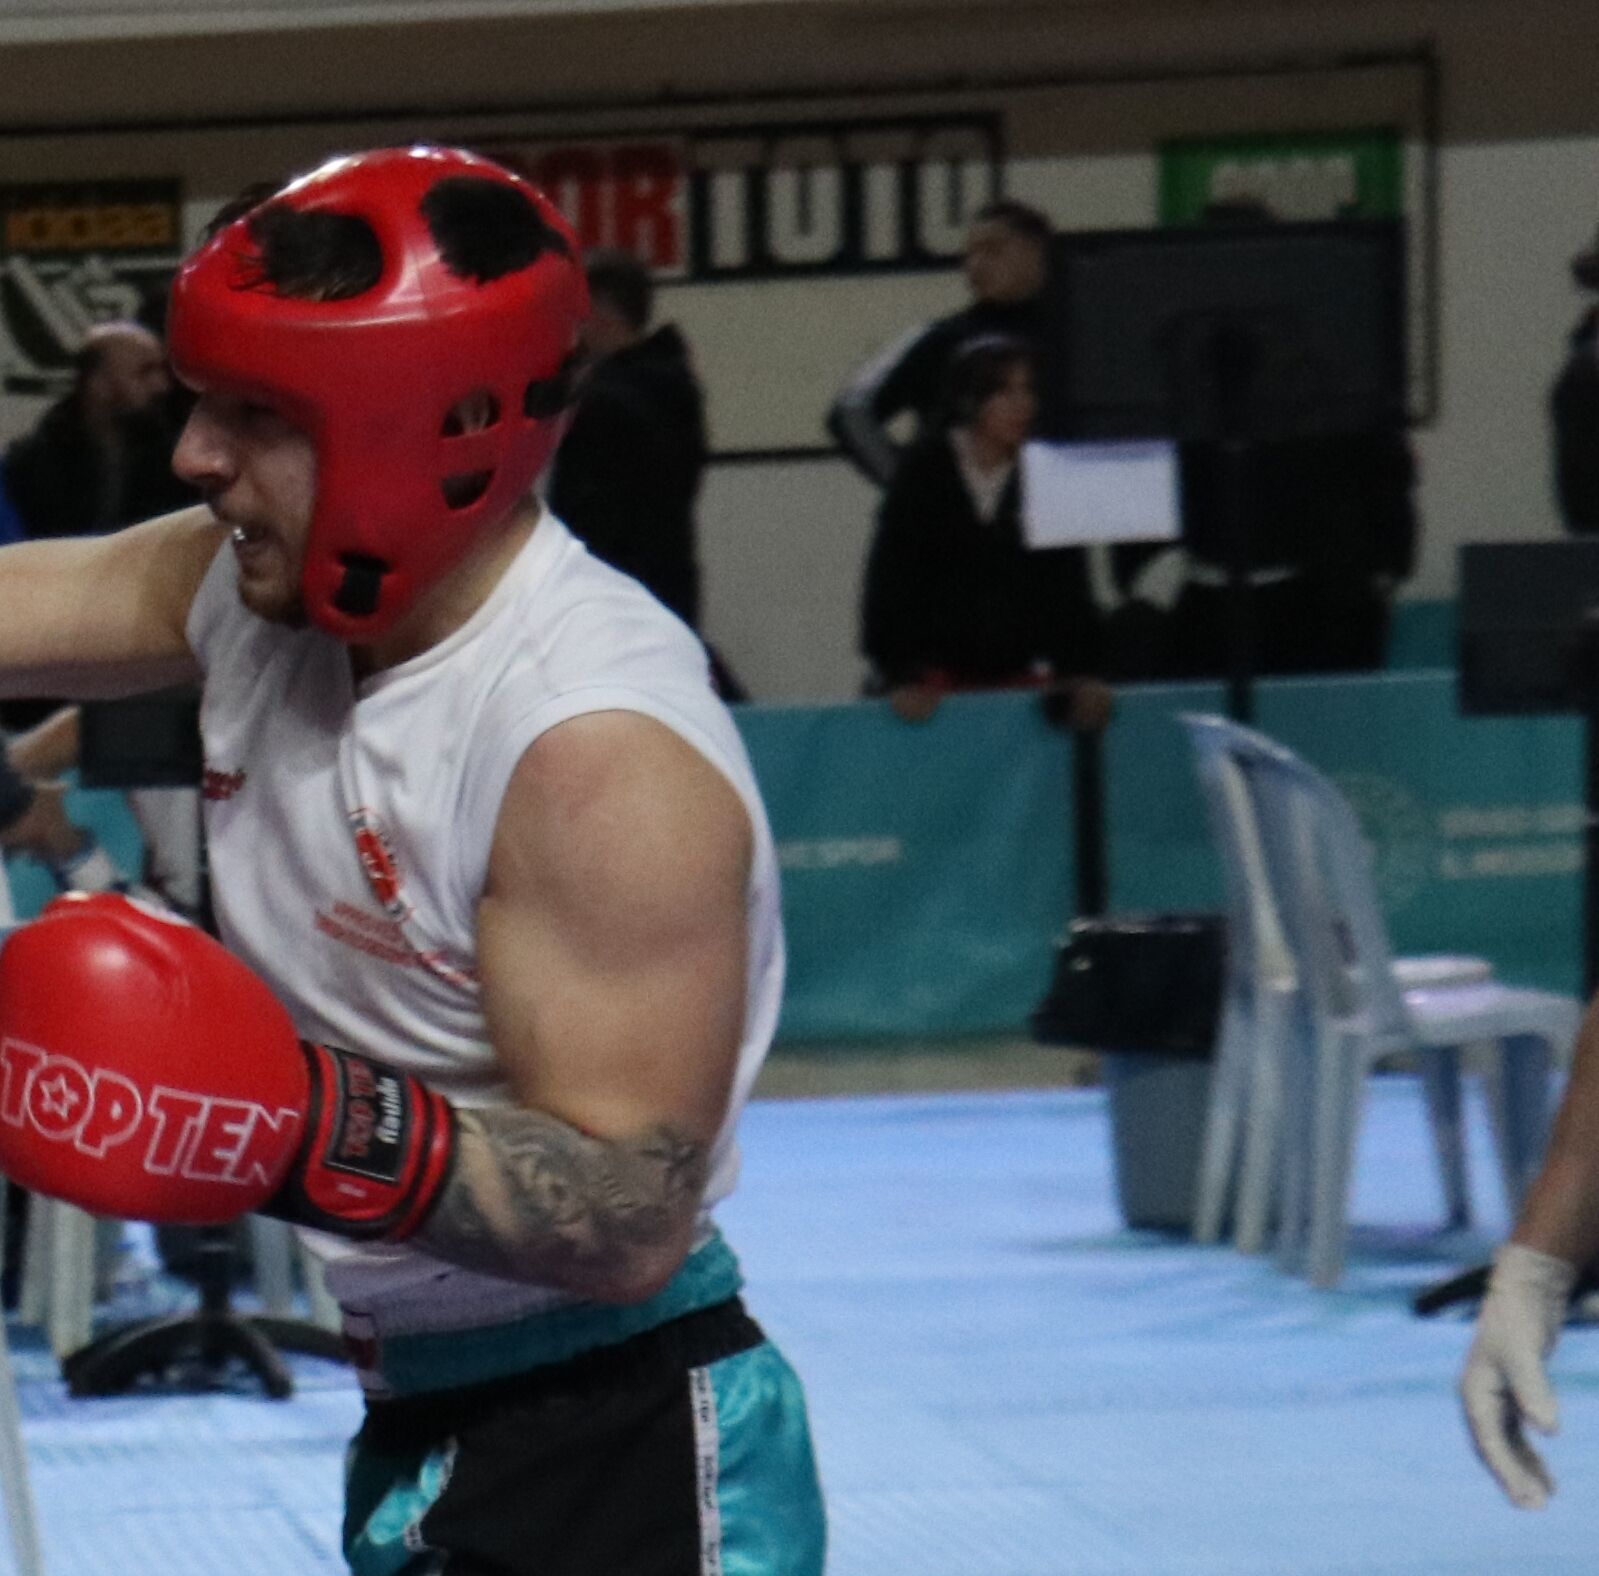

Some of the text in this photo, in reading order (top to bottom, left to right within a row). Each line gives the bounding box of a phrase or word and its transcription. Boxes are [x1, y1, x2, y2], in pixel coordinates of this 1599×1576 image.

[702, 128, 992, 267] TOTO
[0, 1037, 144, 1159] TOP
[144, 1084, 299, 1188] TEN
